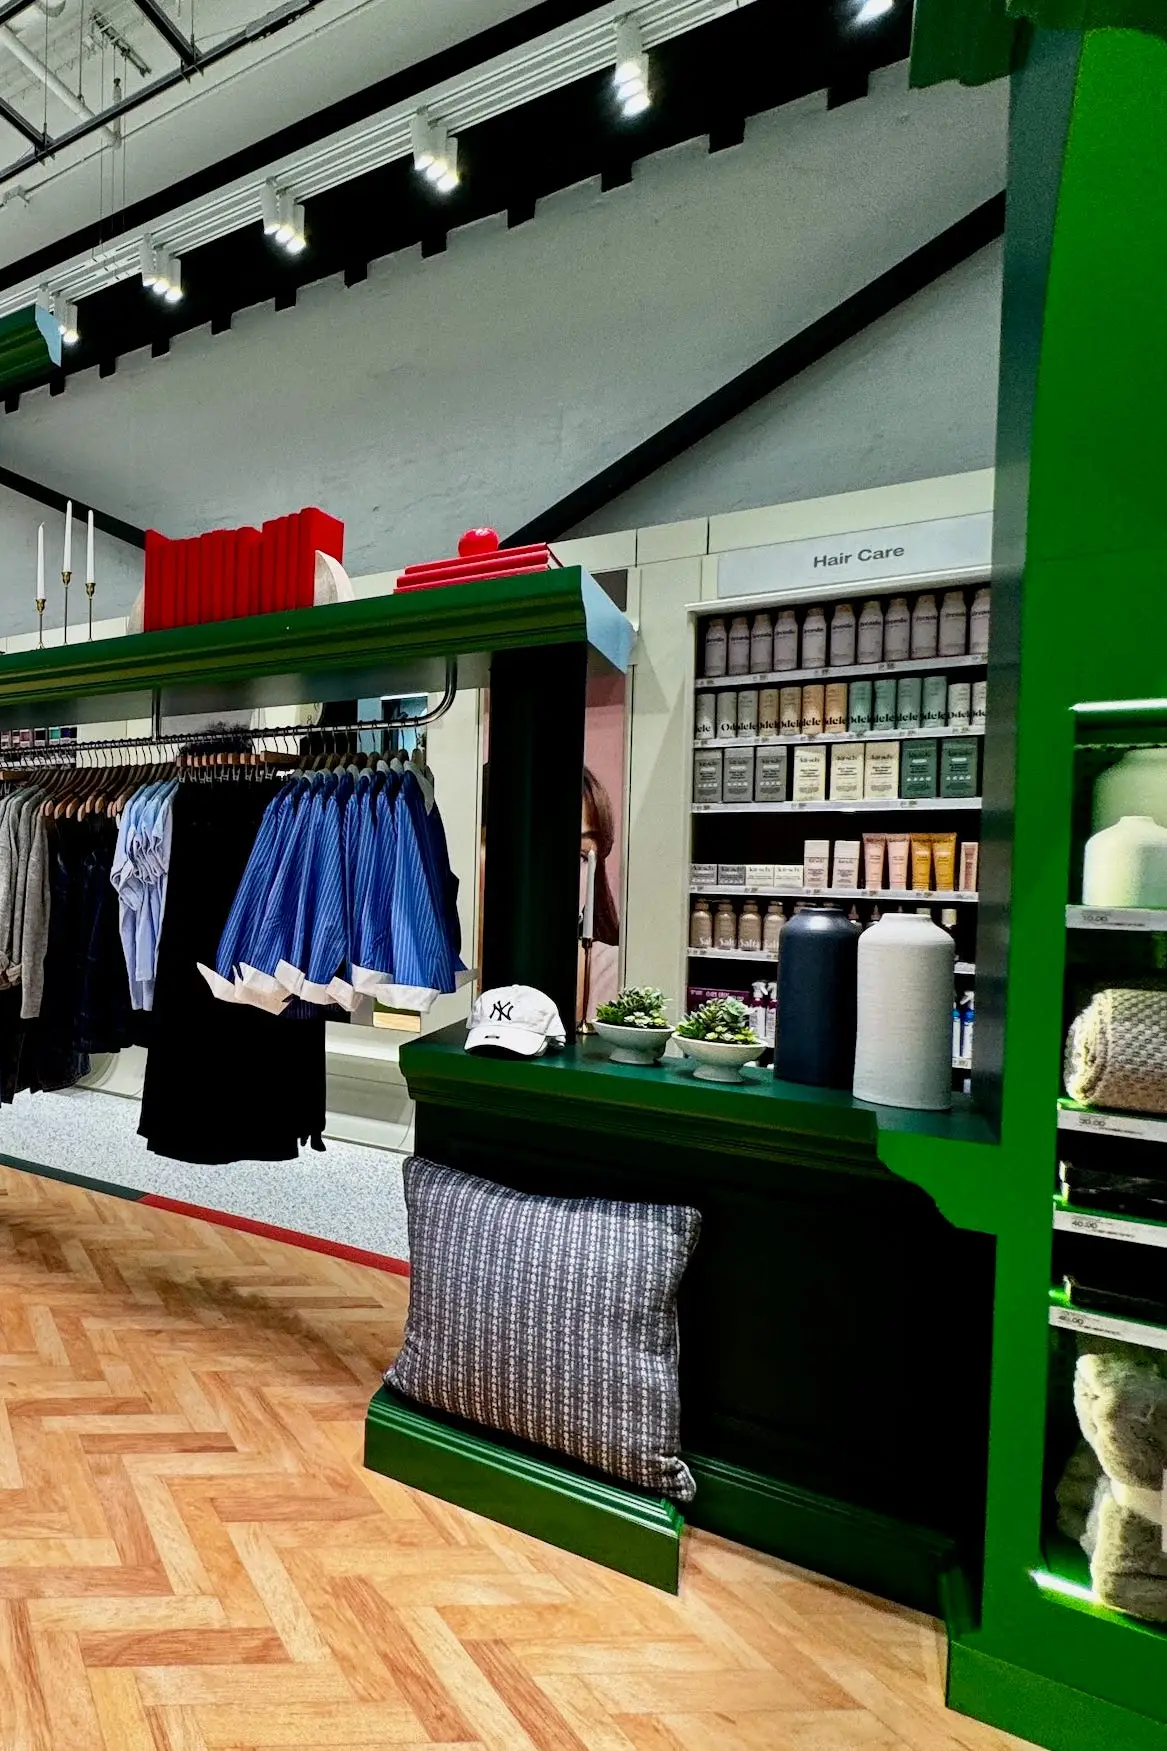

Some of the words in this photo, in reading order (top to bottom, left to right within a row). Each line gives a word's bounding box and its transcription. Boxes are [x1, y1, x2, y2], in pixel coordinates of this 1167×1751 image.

[813, 552, 852, 568] Hair
[857, 547, 905, 562] Care
[489, 1000, 514, 1021] NY
